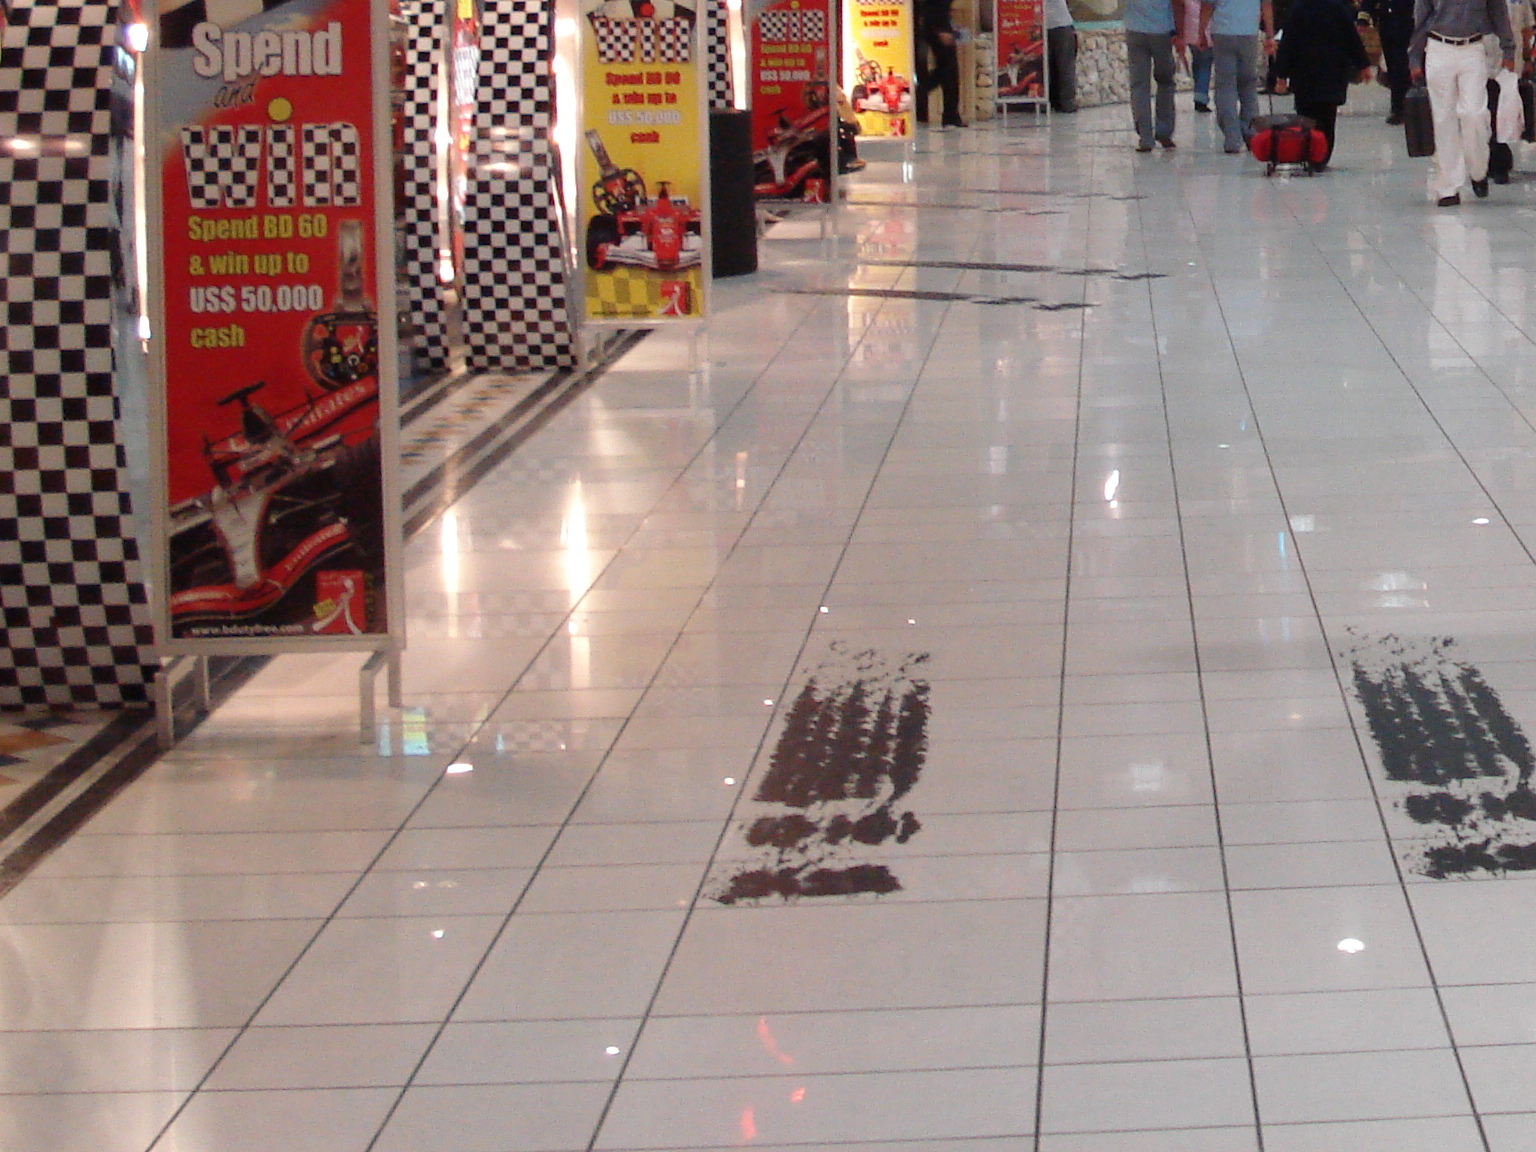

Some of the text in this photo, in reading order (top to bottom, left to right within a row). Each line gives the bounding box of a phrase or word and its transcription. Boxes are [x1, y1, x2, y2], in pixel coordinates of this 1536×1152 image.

[192, 21, 343, 82] Spend
[214, 61, 263, 108] and
[188, 213, 328, 242] Spend BD 60
[189, 250, 310, 277] & win up to
[189, 285, 237, 315] US$
[190, 323, 246, 348] cash
